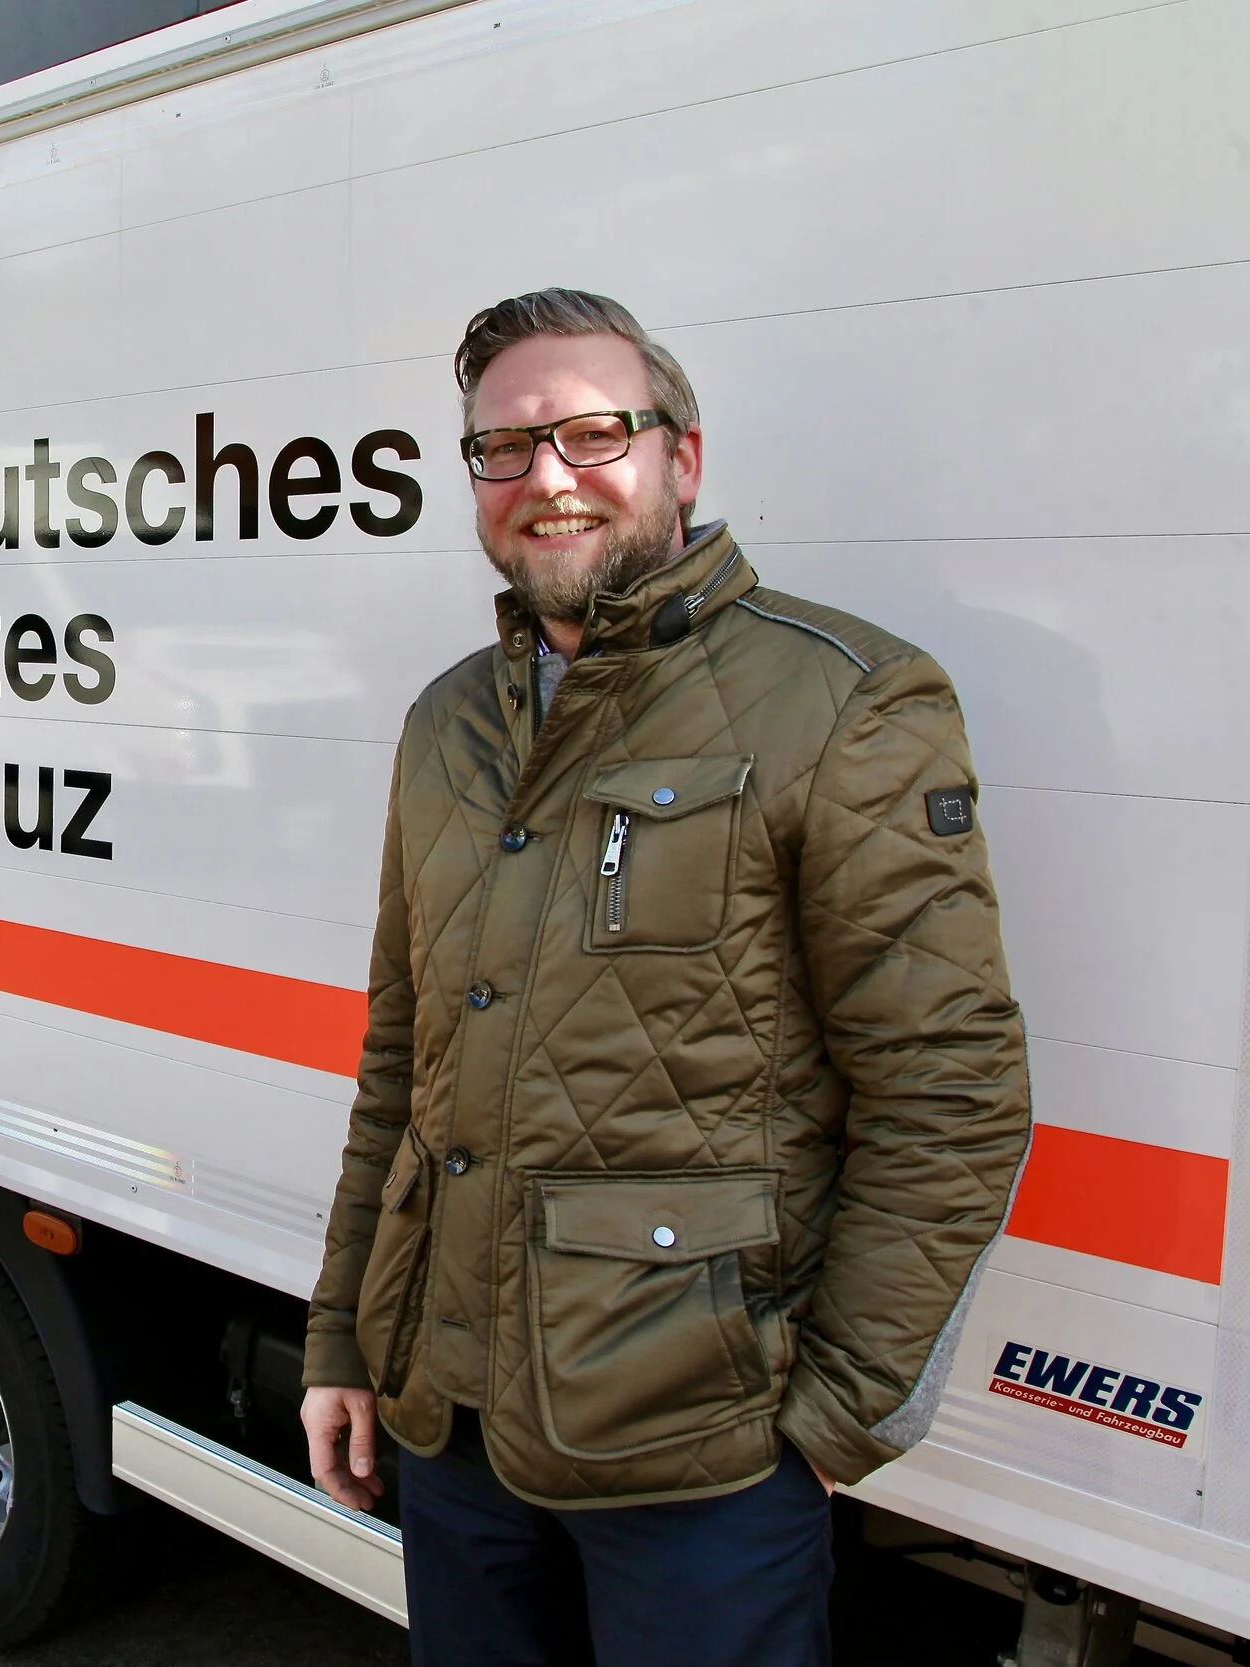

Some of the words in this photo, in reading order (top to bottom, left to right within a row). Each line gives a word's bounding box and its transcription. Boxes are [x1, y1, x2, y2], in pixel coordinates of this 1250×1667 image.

[993, 1341, 1203, 1431] EWERS
[994, 1382, 1064, 1408] Karosserie-
[1068, 1404, 1093, 1418] und
[1096, 1412, 1181, 1445] Fahrzeugbau
